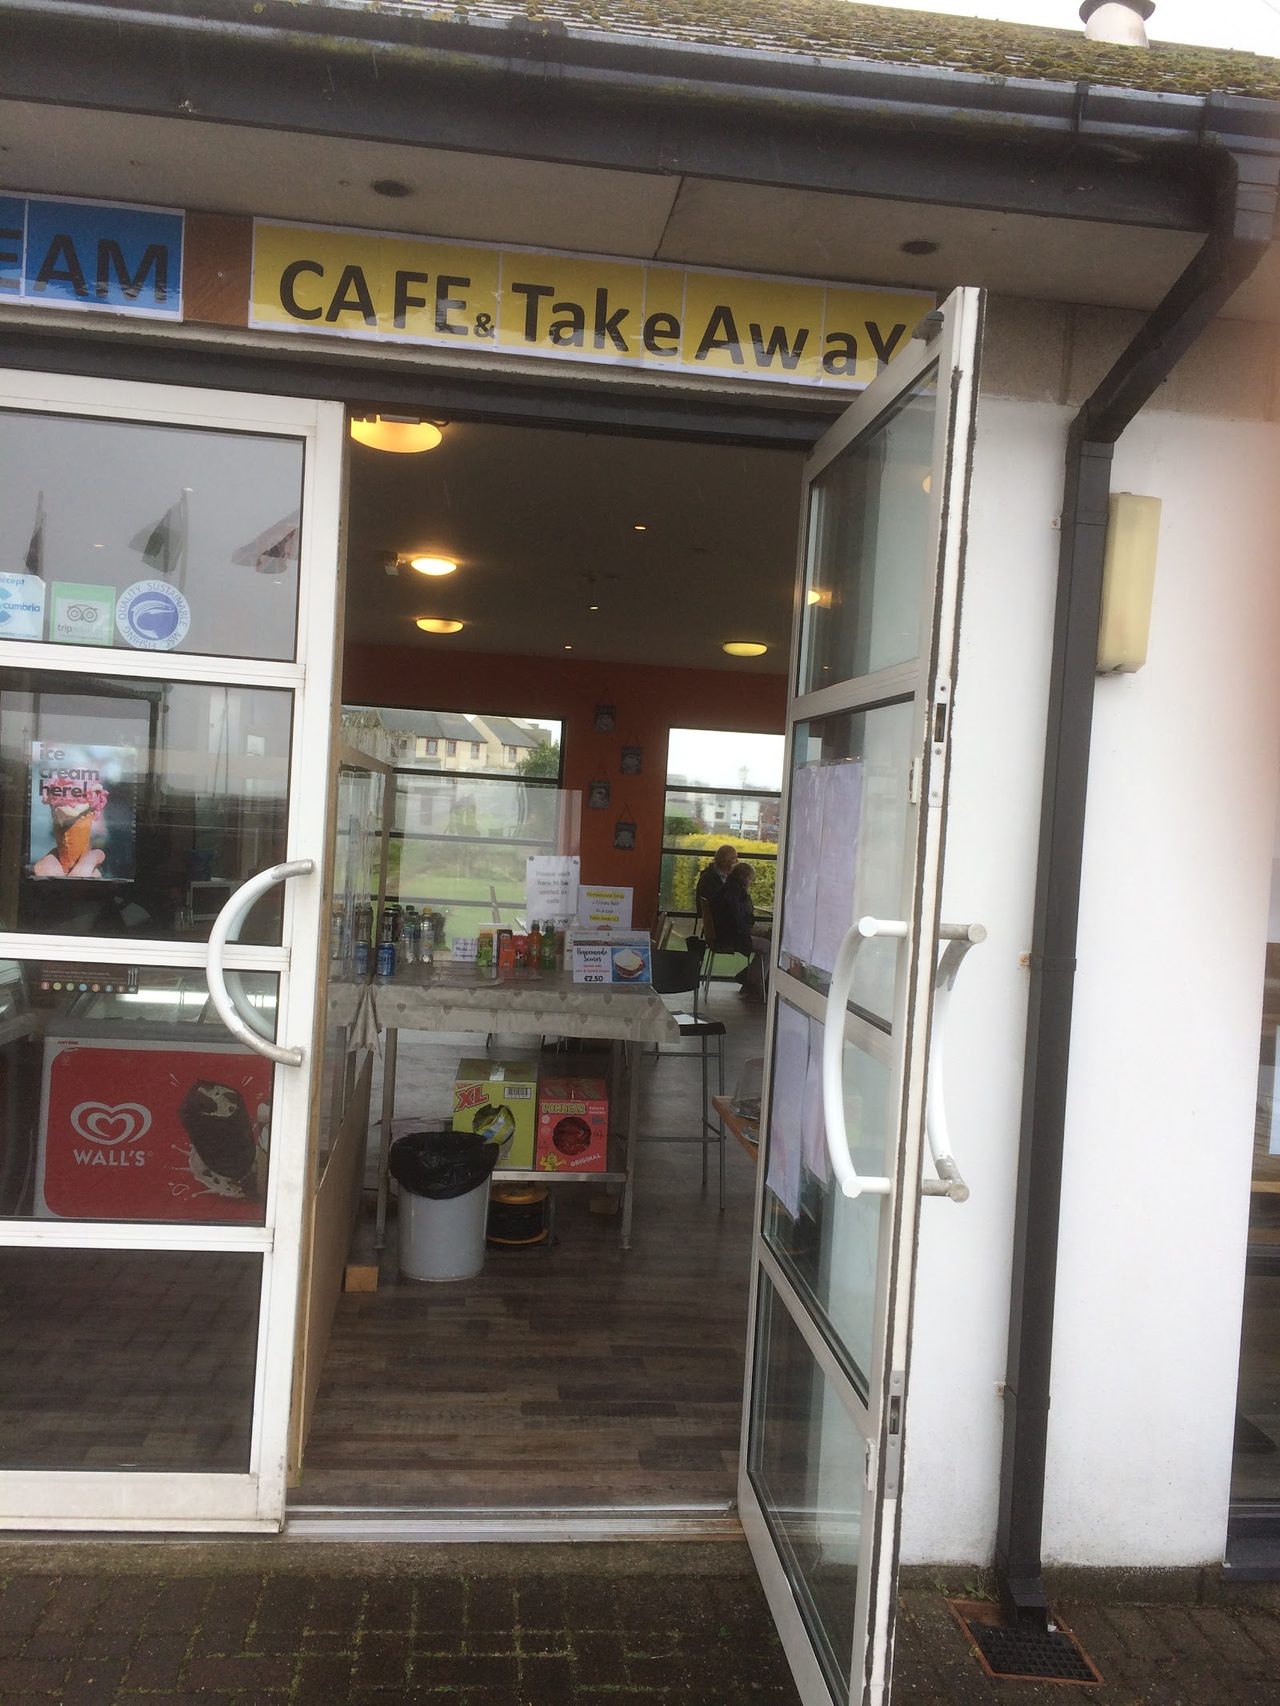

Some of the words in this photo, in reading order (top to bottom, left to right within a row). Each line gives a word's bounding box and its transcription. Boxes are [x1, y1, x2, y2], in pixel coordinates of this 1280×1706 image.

[279, 259, 470, 335] CAFE
[473, 312, 496, 338] &
[119, 584, 142, 620] QUALITY
[147, 582, 188, 627] SUSTAINABLE
[165, 630, 182, 648] MSC
[40, 743, 65, 760] ice
[39, 768, 100, 780] cream
[39, 779, 88, 798] here!
[455, 1085, 489, 1111] XL
[73, 1149, 145, 1167] WALL'S
[570, 1153, 601, 1167] ORIGINAL
